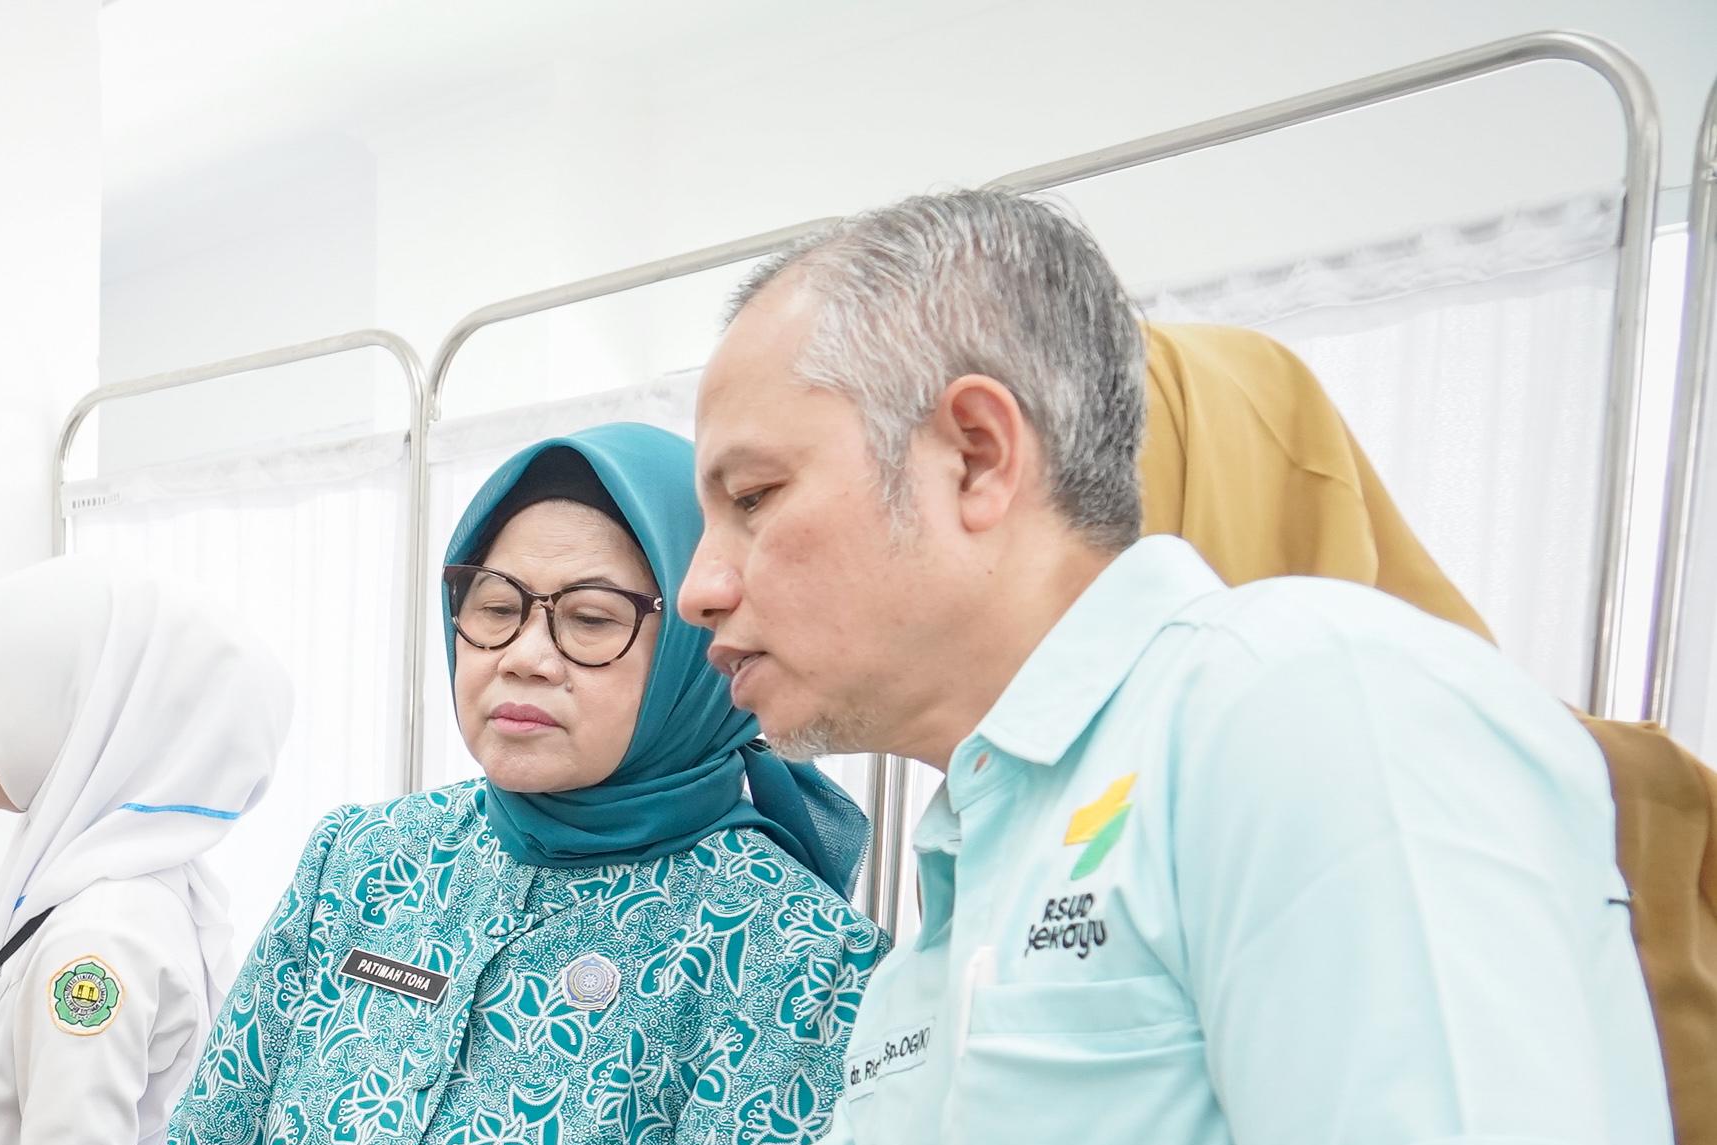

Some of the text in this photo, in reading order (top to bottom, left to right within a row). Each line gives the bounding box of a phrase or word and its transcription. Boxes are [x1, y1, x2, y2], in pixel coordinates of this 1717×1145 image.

[1042, 893, 1095, 922] RSUD
[1025, 920, 1107, 959] Sekayu
[357, 958, 431, 991] PATIMAH TOHA
